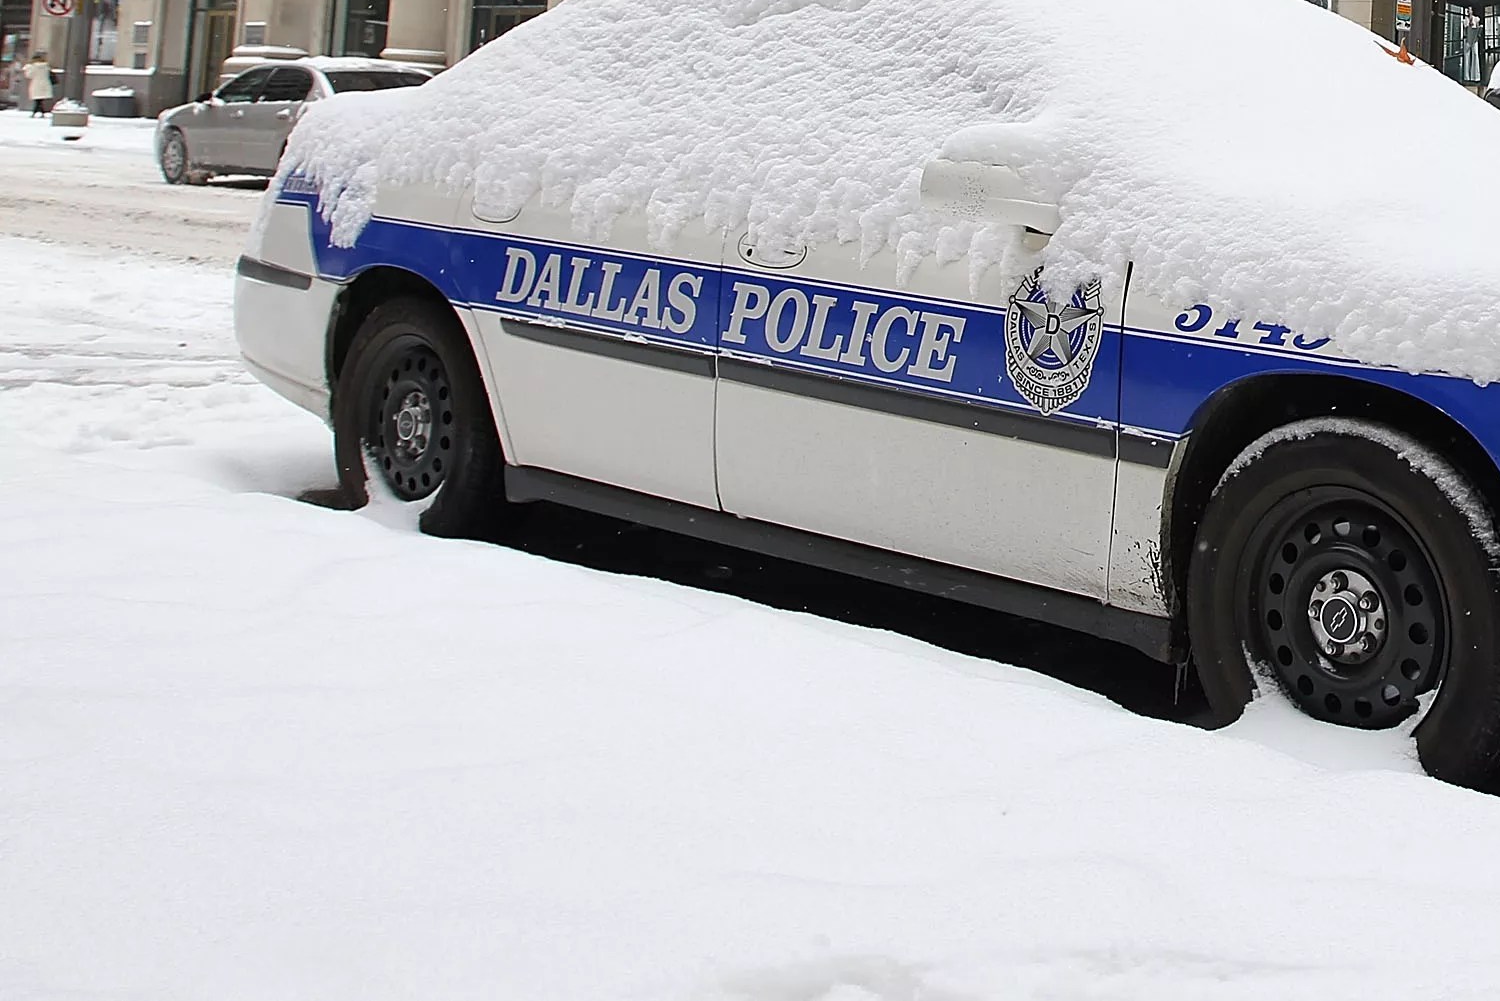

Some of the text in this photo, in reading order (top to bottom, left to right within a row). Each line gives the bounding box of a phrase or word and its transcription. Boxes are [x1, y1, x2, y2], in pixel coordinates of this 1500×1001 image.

[496, 247, 967, 383] DALLAS POLICE
[1046, 314, 1061, 335] D
[1010, 312, 1097, 370] DALLAS TEXAS
[1016, 372, 1081, 397] SINCE 1881
